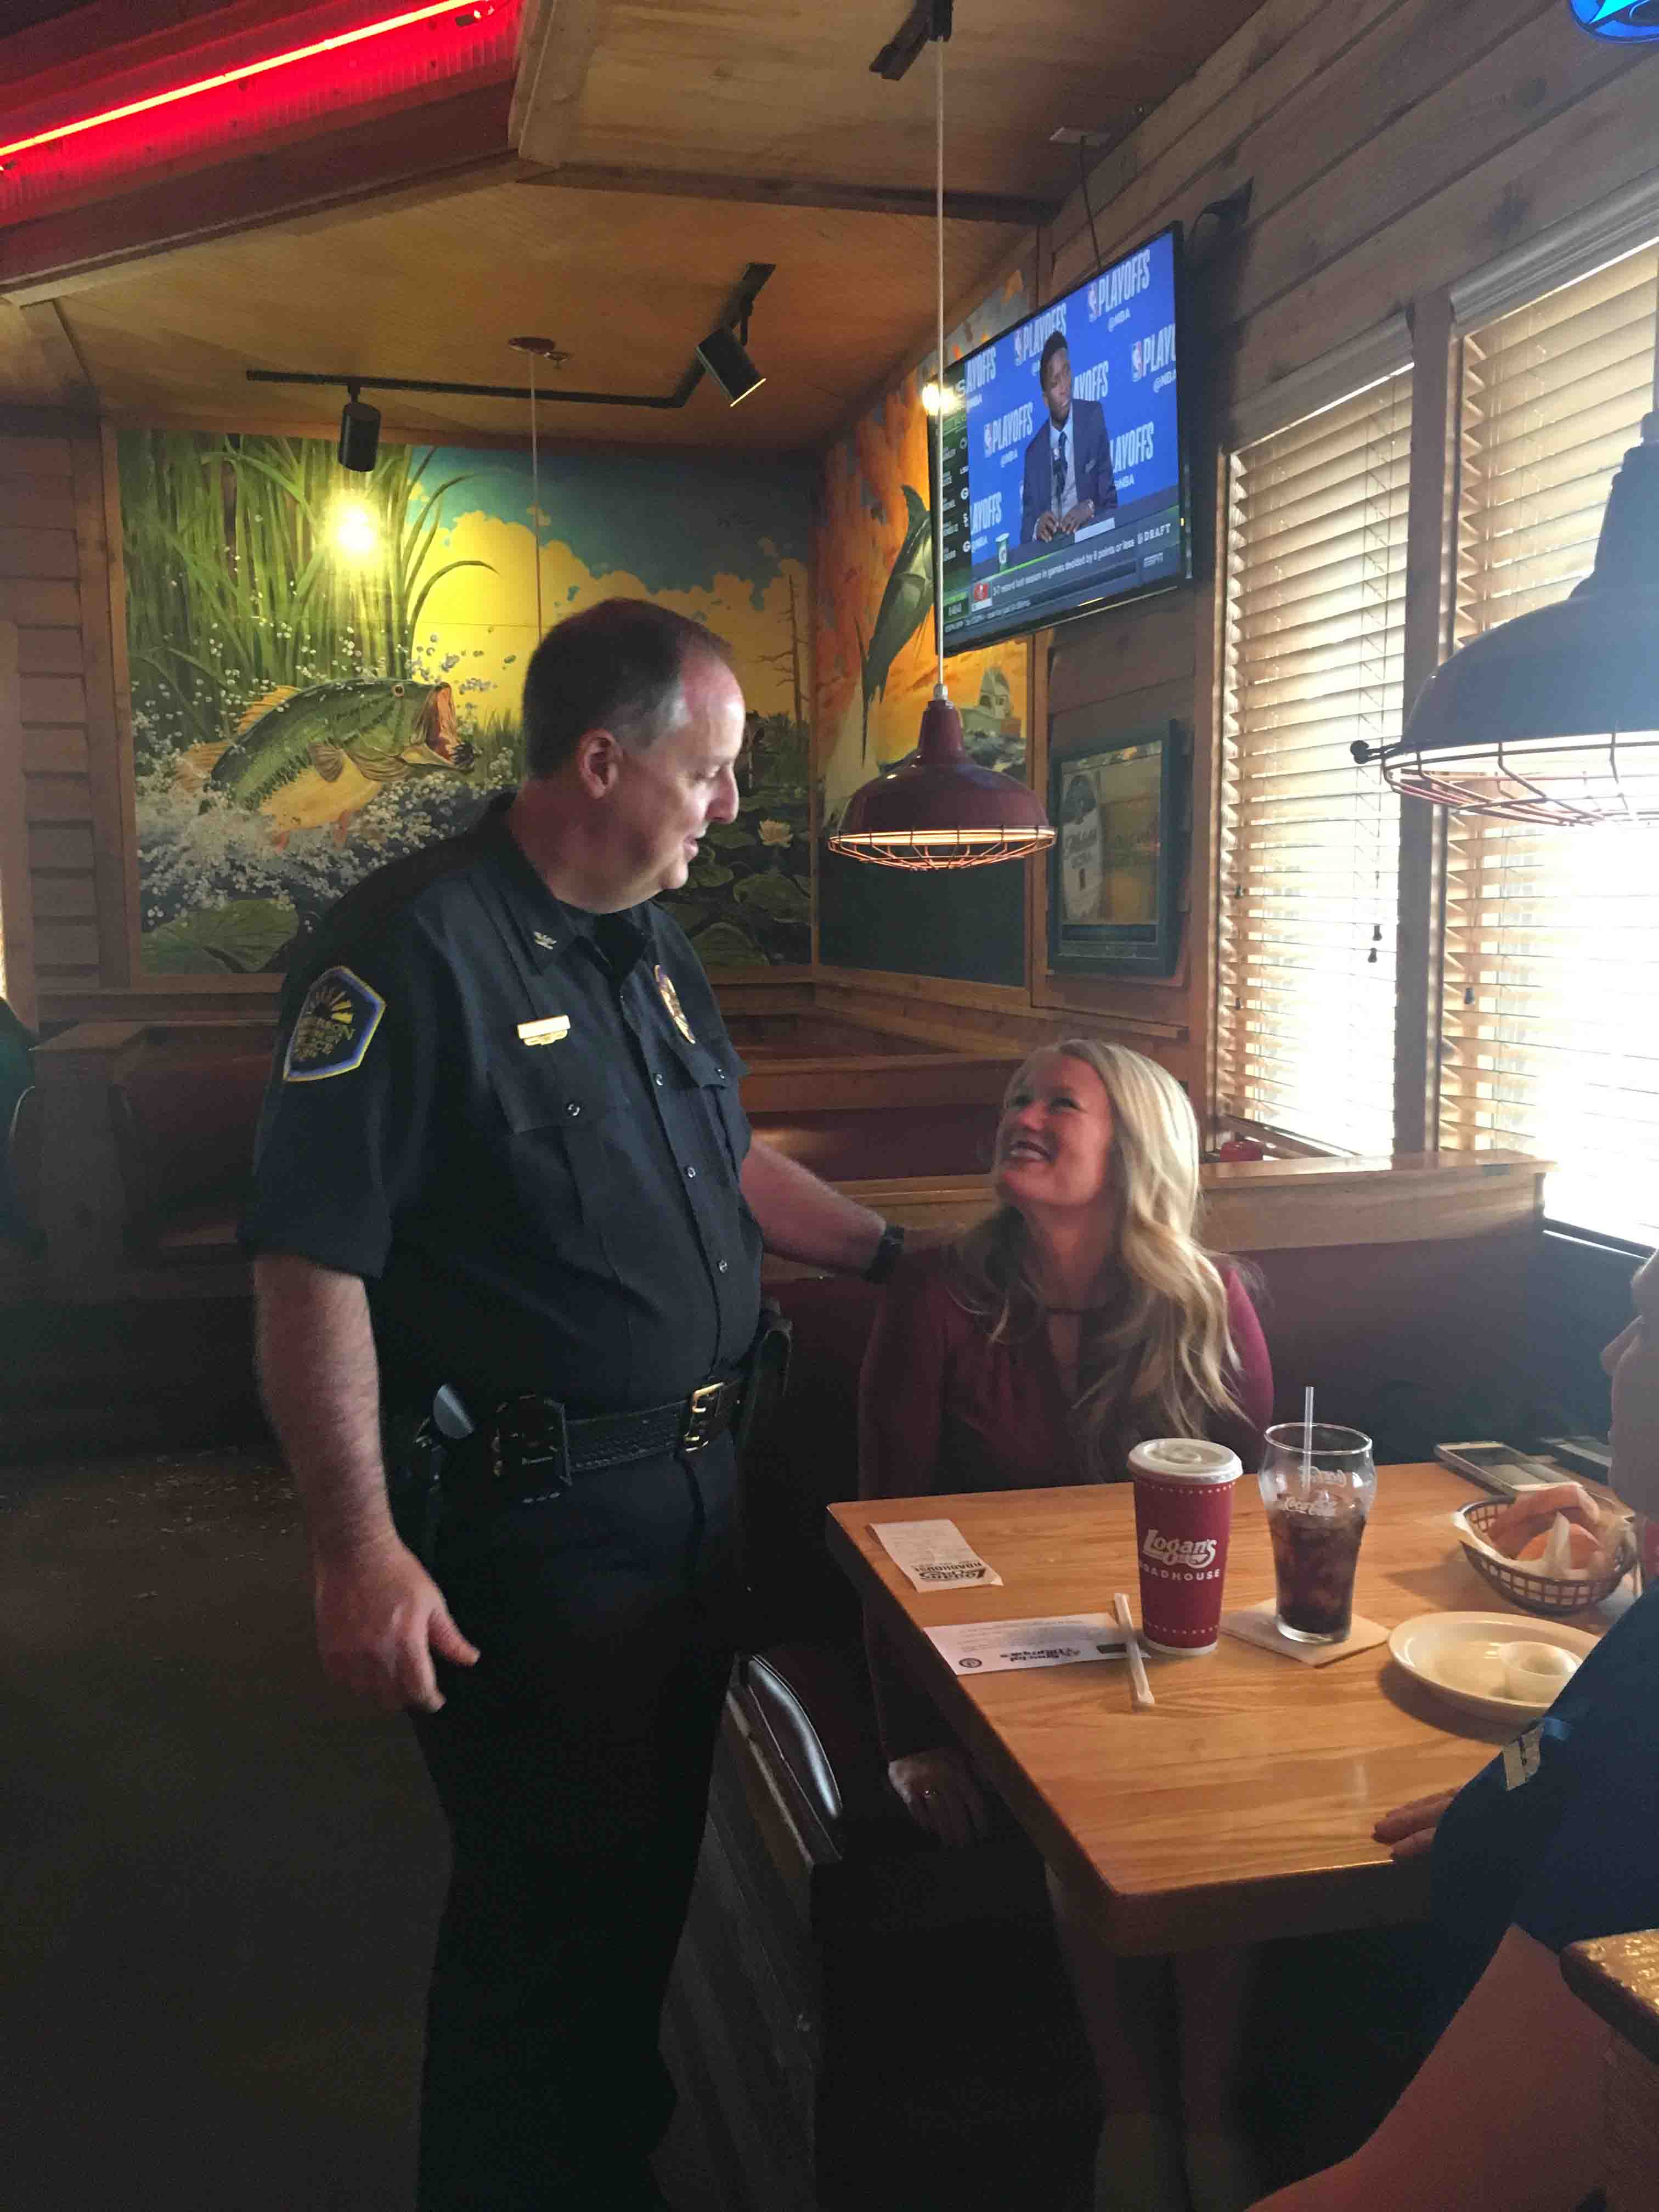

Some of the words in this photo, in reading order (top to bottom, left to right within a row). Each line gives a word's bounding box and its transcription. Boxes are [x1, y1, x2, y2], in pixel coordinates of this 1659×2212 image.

[1099, 249, 1150, 317] PLAYOFFS
[992, 402, 1033, 453] PLAYOFFS
[1144, 523, 1171, 542] DRAFT
[1141, 1562, 1221, 1582] OADHOUSE
